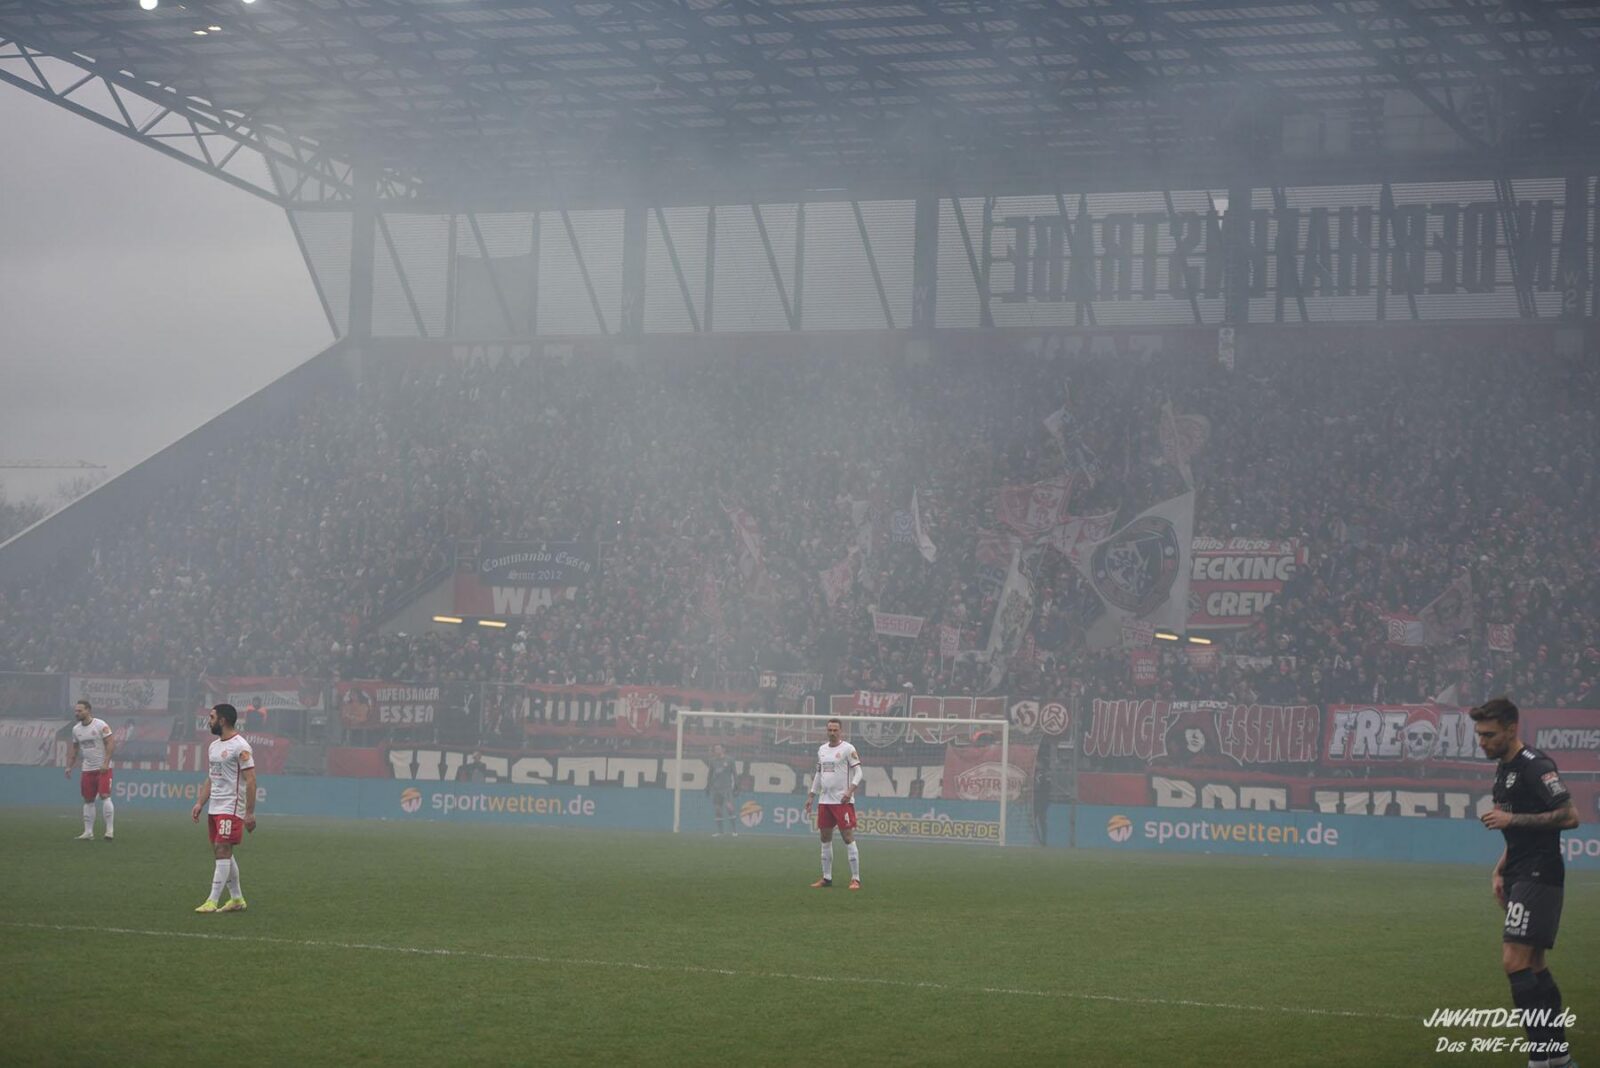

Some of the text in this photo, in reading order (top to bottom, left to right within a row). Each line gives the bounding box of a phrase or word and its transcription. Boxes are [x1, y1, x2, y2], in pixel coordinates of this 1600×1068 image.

[1190, 556, 1297, 581] ECKING
[1083, 699, 1171, 758] JUNGE
[431, 791, 595, 818] sportwetten.de
[1144, 820, 1339, 848] sportwetten.de
